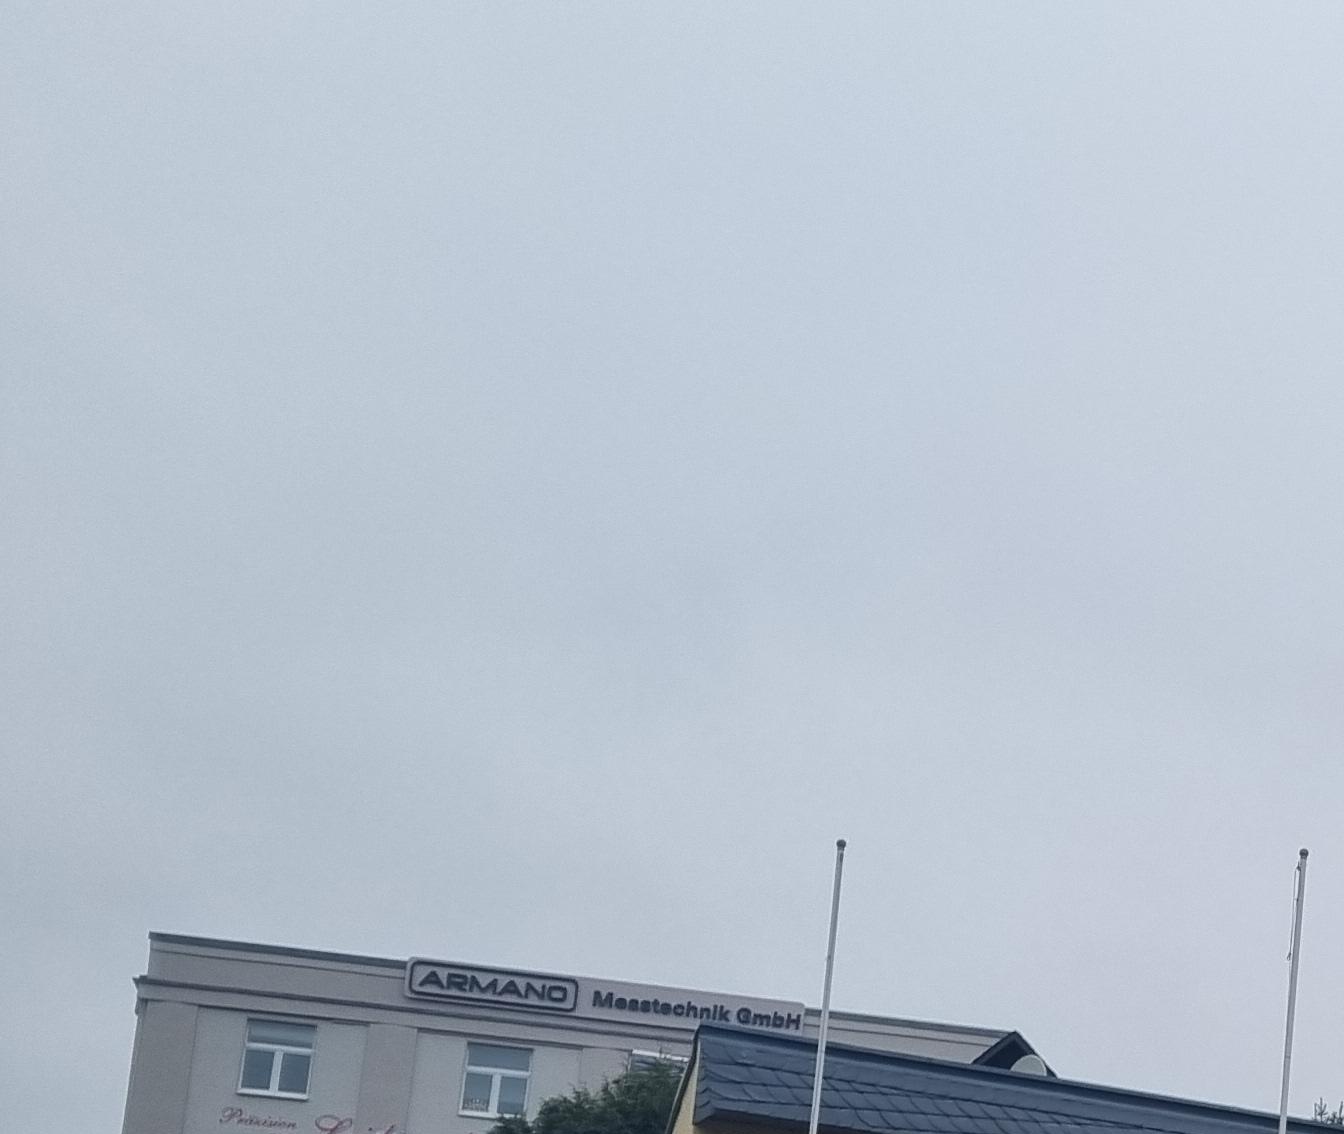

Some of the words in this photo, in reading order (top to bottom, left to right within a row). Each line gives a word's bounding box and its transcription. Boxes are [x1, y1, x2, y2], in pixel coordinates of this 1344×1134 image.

[418, 970, 568, 1002] ARMANO
[592, 990, 731, 1023] Messtechnik
[736, 1007, 802, 1031] GmbH
[219, 1106, 298, 1129] Präzision
